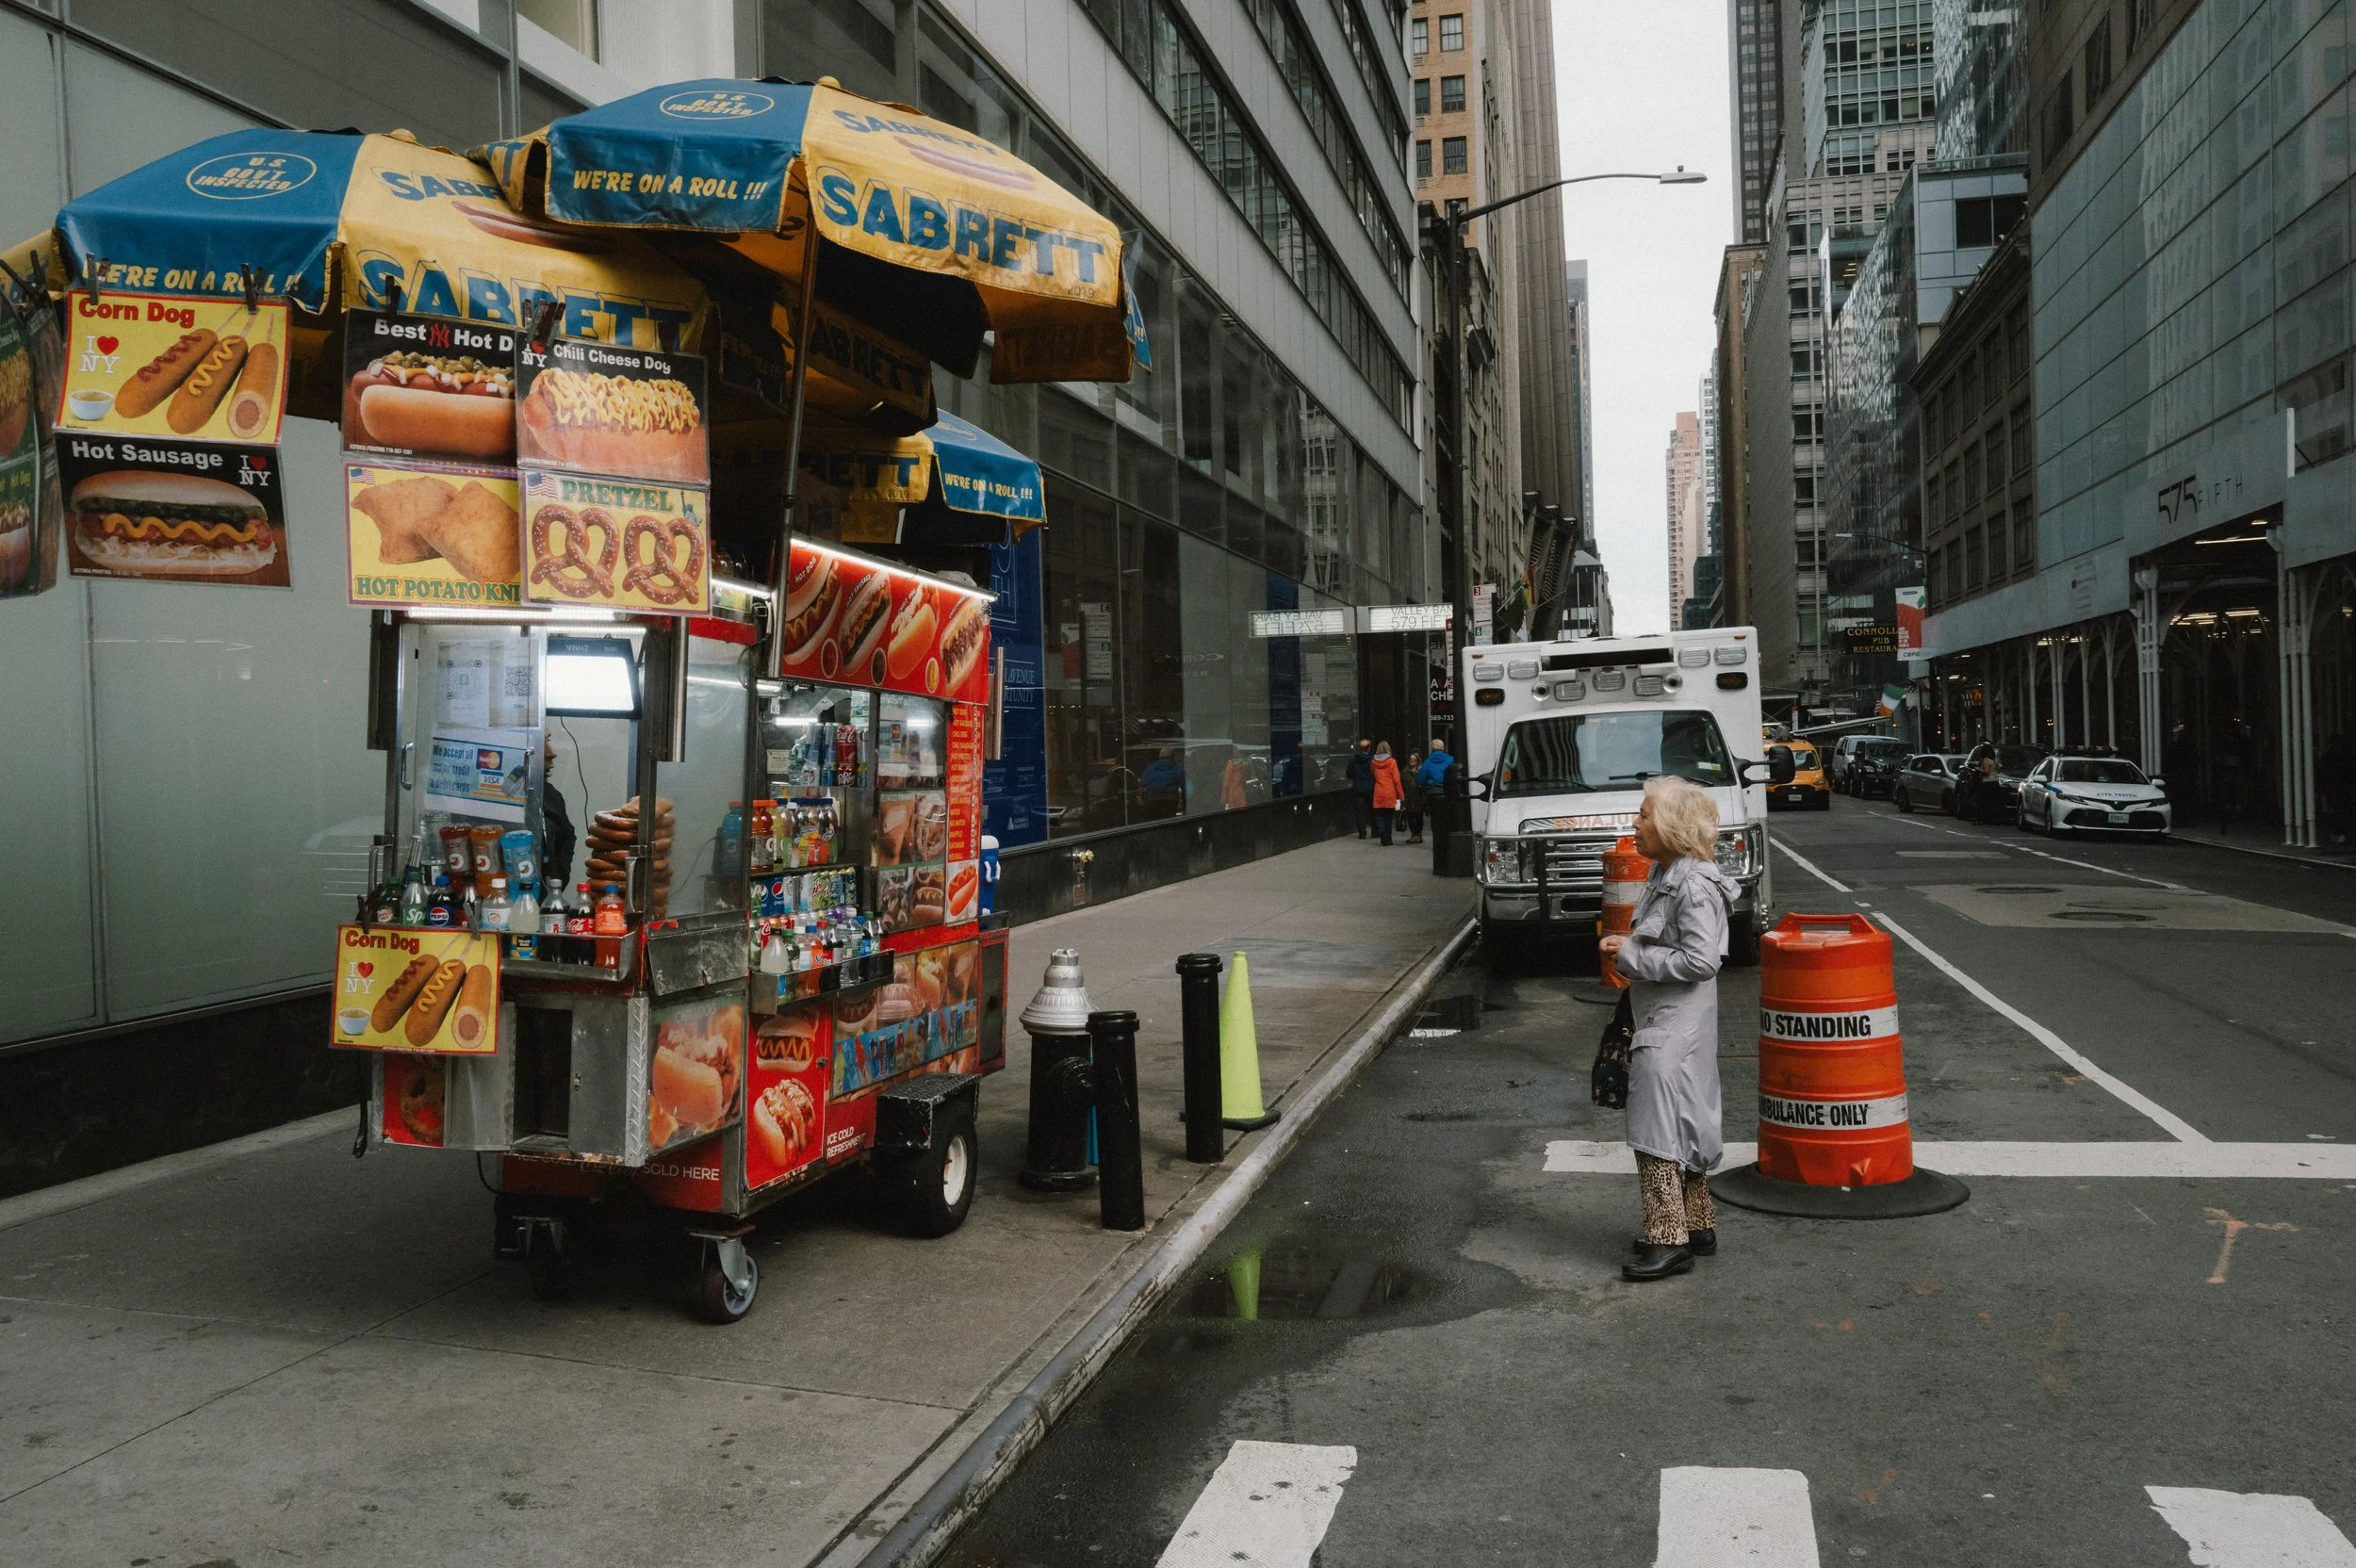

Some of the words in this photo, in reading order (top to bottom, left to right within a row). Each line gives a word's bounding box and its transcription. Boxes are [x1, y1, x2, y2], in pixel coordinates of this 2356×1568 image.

[831, 108, 998, 156] SABRETT
[194, 175, 292, 190] INSPECTED
[573, 170, 631, 192] WE'RE
[638, 173, 667, 194] ON
[667, 175, 683, 194] A
[688, 177, 738, 200] ROLL
[817, 168, 1106, 286] SABRETT
[164, 269, 198, 291] ON
[200, 270, 216, 292] A
[1067, 285, 1096, 299] 2019
[78, 297, 139, 321] Corn
[147, 302, 195, 328] Dog
[373, 318, 427, 342] Best
[453, 331, 493, 351] Hot
[78, 354, 122, 375] NY
[521, 351, 548, 368] NY
[553, 344, 585, 361] Chili
[588, 349, 641, 368] Cheese
[72, 440, 115, 460] Hot
[122, 444, 223, 470] Sausage
[238, 470, 271, 486] NY
[944, 471, 971, 491] WE'RE
[972, 479, 987, 493] ON
[995, 483, 1018, 498] ROLL
[561, 480, 674, 513] PRETZEL
[2157, 474, 2198, 524] 575
[355, 576, 400, 597] HOT
[403, 579, 483, 600] POTATO
[1475, 587, 1480, 596] 3
[1391, 605, 1429, 615] VALLEY
[1391, 616, 1416, 629] 579
[1476, 627, 1481, 636] 6
[1847, 627, 1898, 636] CONNOLL
[1853, 645, 1897, 653] RESTAURA
[1873, 636, 1890, 645] PUB
[1006, 668, 1035, 685] AVENUE
[433, 743, 443, 757] We
[443, 746, 465, 761] accept
[465, 748, 474, 760] all
[433, 762, 450, 776] major
[451, 763, 470, 776] credit
[450, 780, 469, 793] cards
[483, 776, 500, 785] VISA
[345, 930, 386, 950] Corn
[390, 933, 420, 955] Dog
[345, 978, 375, 995] NY
[698, 1002, 717, 1020] DOG
[1775, 1014, 1872, 1037] STANDING
[1830, 1103, 1869, 1127] ONLY
[827, 1132, 838, 1146] ICE
[838, 1126, 855, 1141] COLD
[826, 1133, 867, 1160] REFRESHMENT
[643, 1162, 679, 1178] SOLD
[682, 1167, 721, 1182] HERE
